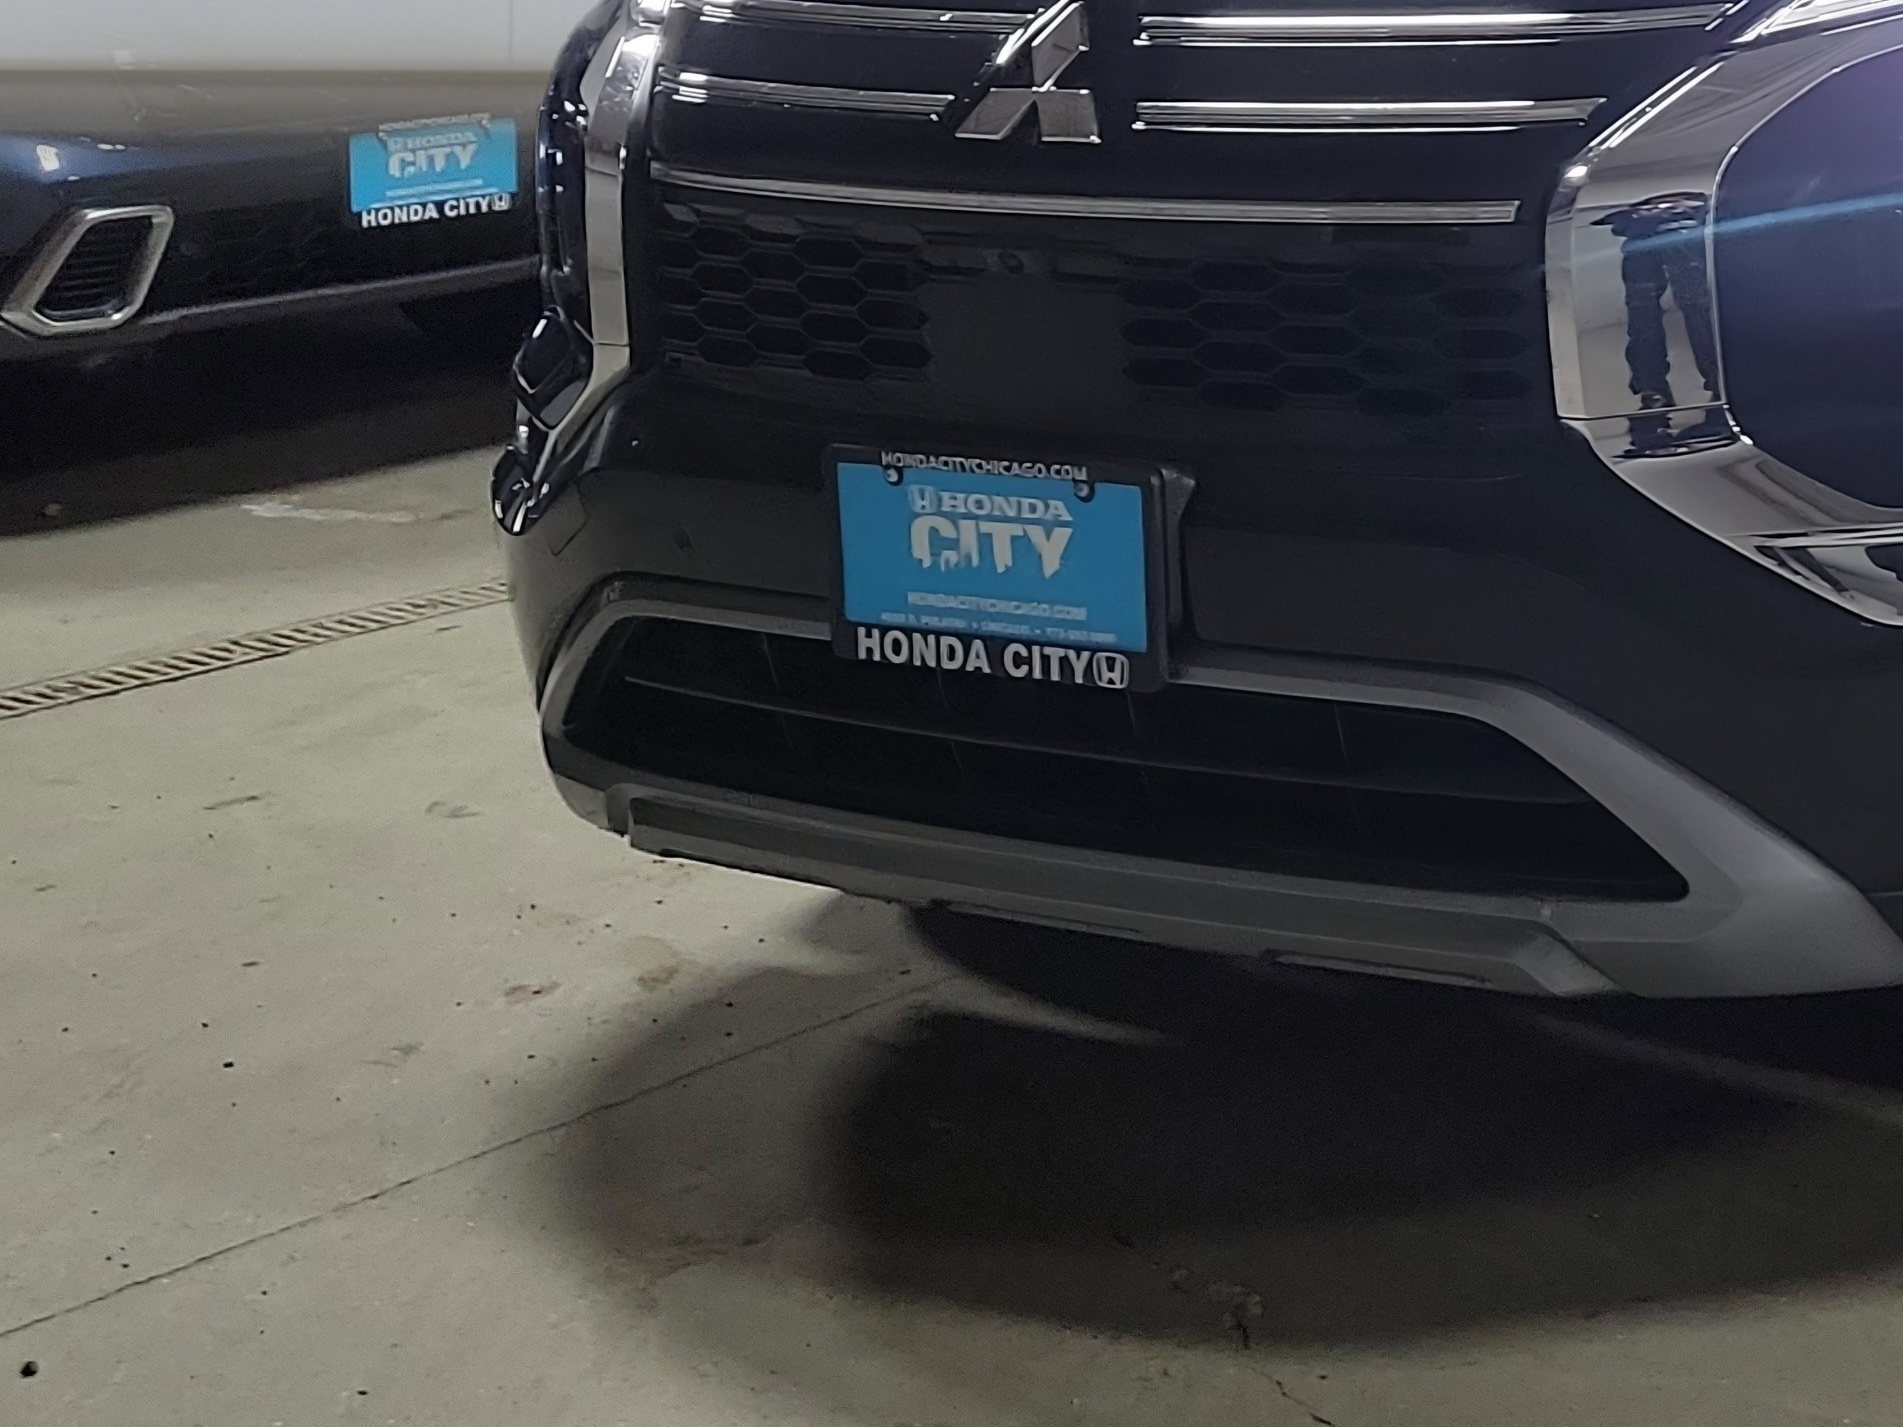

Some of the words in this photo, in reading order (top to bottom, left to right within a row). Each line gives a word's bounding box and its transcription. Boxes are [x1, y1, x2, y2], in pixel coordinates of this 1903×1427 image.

[388, 143, 479, 178] CITY
[362, 205, 439, 228] HONDA
[444, 196, 491, 217] CITY
[940, 492, 1073, 521] HONDA
[910, 515, 1073, 578] CITY
[857, 627, 991, 673] HONDA
[1003, 644, 1092, 684] CITY
